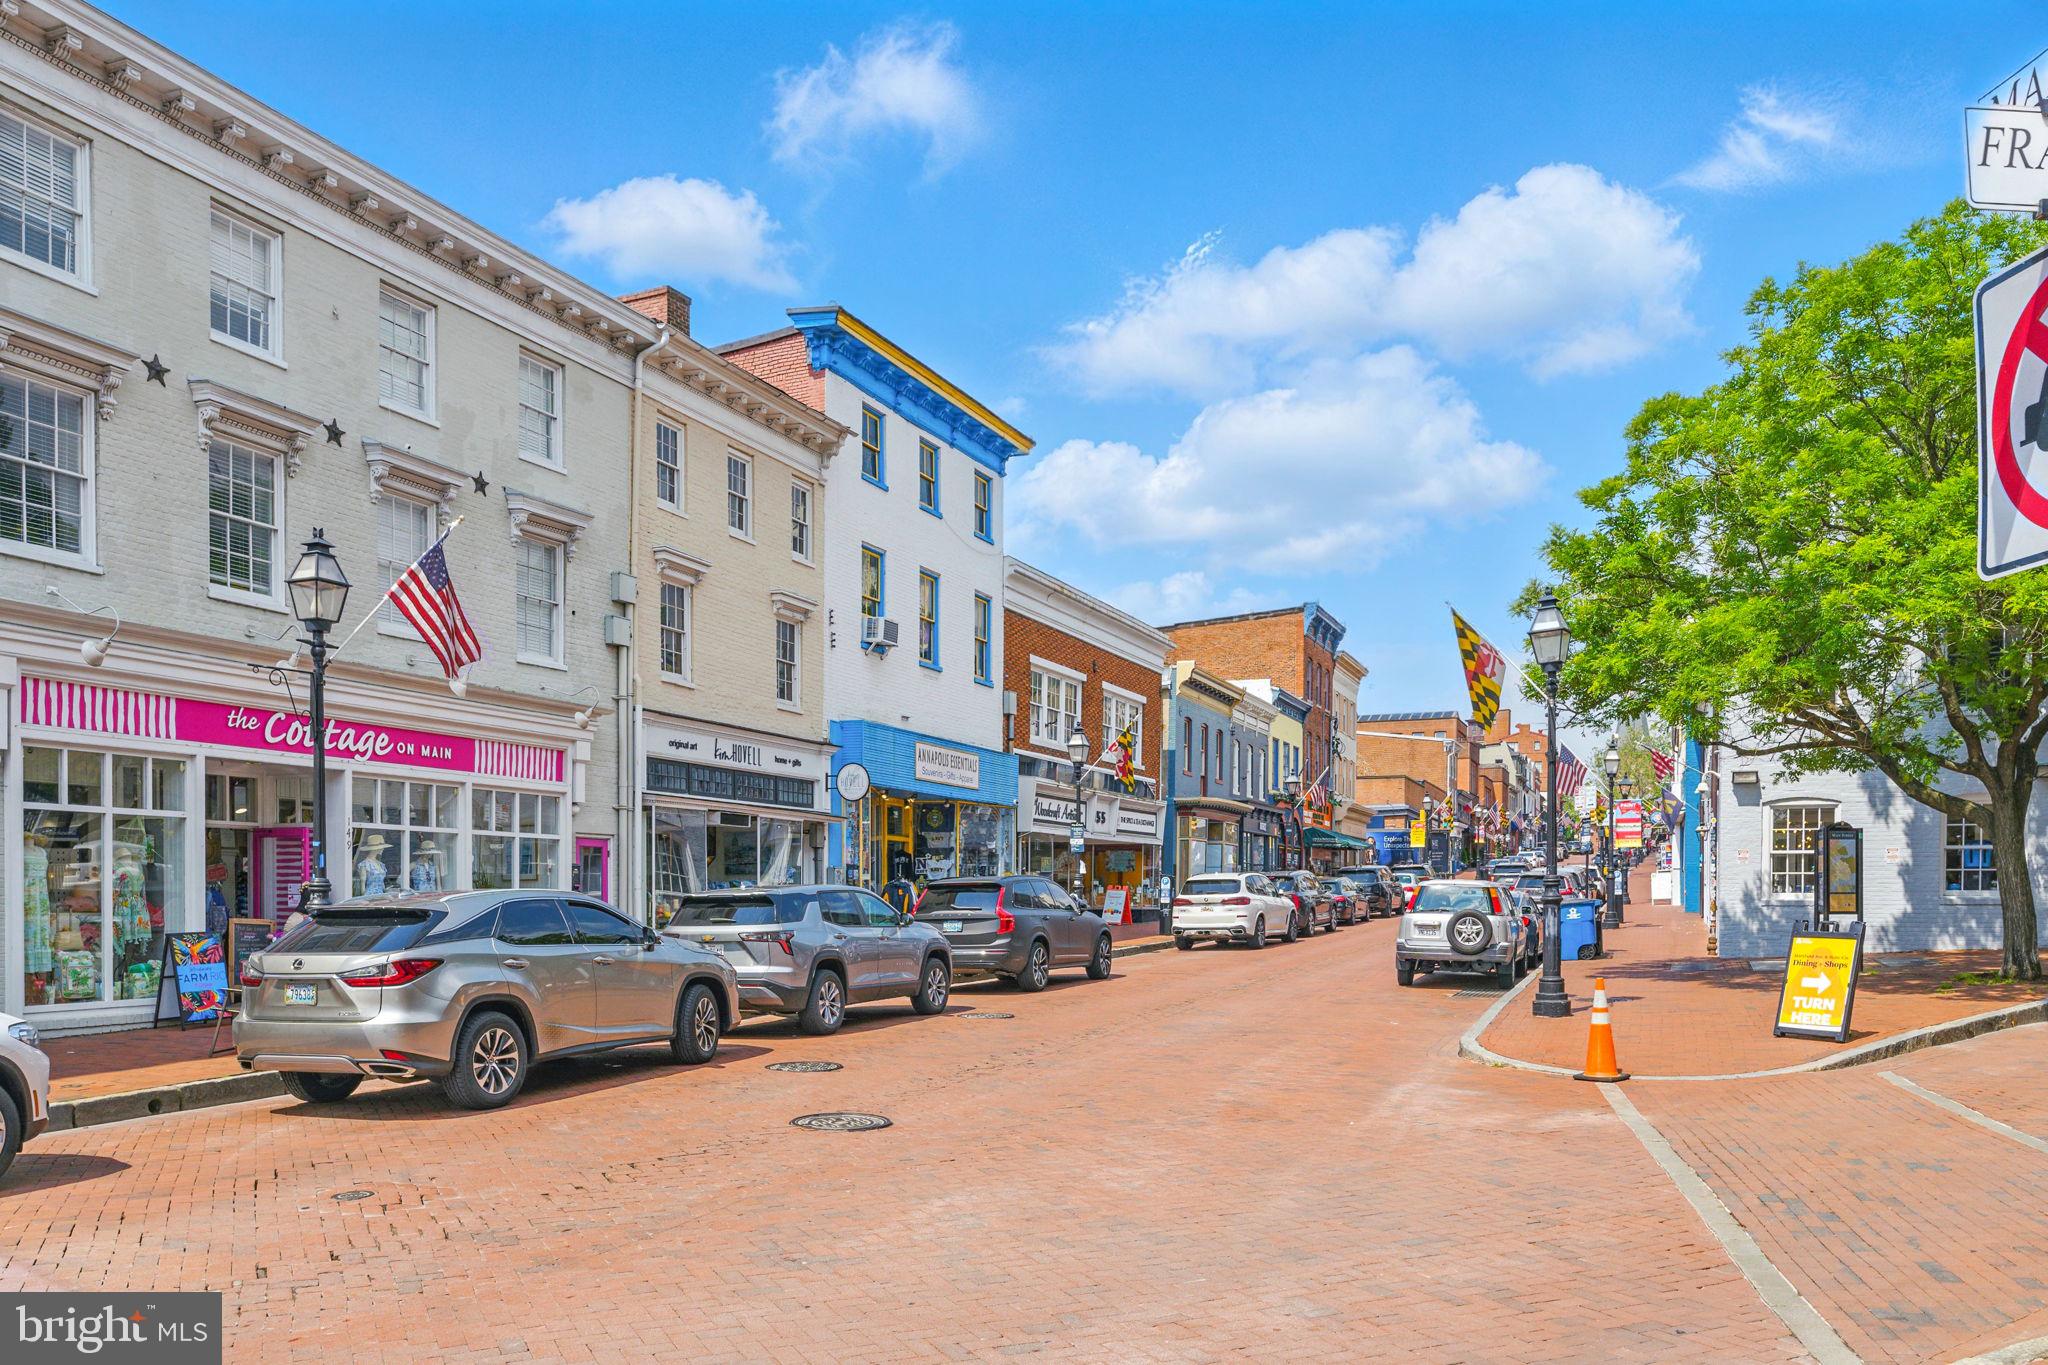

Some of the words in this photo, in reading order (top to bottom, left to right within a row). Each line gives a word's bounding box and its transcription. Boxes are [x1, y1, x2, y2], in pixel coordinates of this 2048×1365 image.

[227, 707, 260, 730] the
[397, 742, 414, 755] ON
[422, 745, 452, 760] MAIN
[668, 739, 689, 750] original
[733, 744, 762, 767] HOVELL
[918, 748, 949, 767] ANNAPOLIS
[951, 755, 978, 773] ESSENTIALS
[1096, 811, 1107, 824] 55
[1793, 960, 1817, 968] Dining
[1824, 961, 1848, 970] Shops
[1793, 996, 1835, 1011] TURN
[1791, 1012, 1832, 1026] HERE
